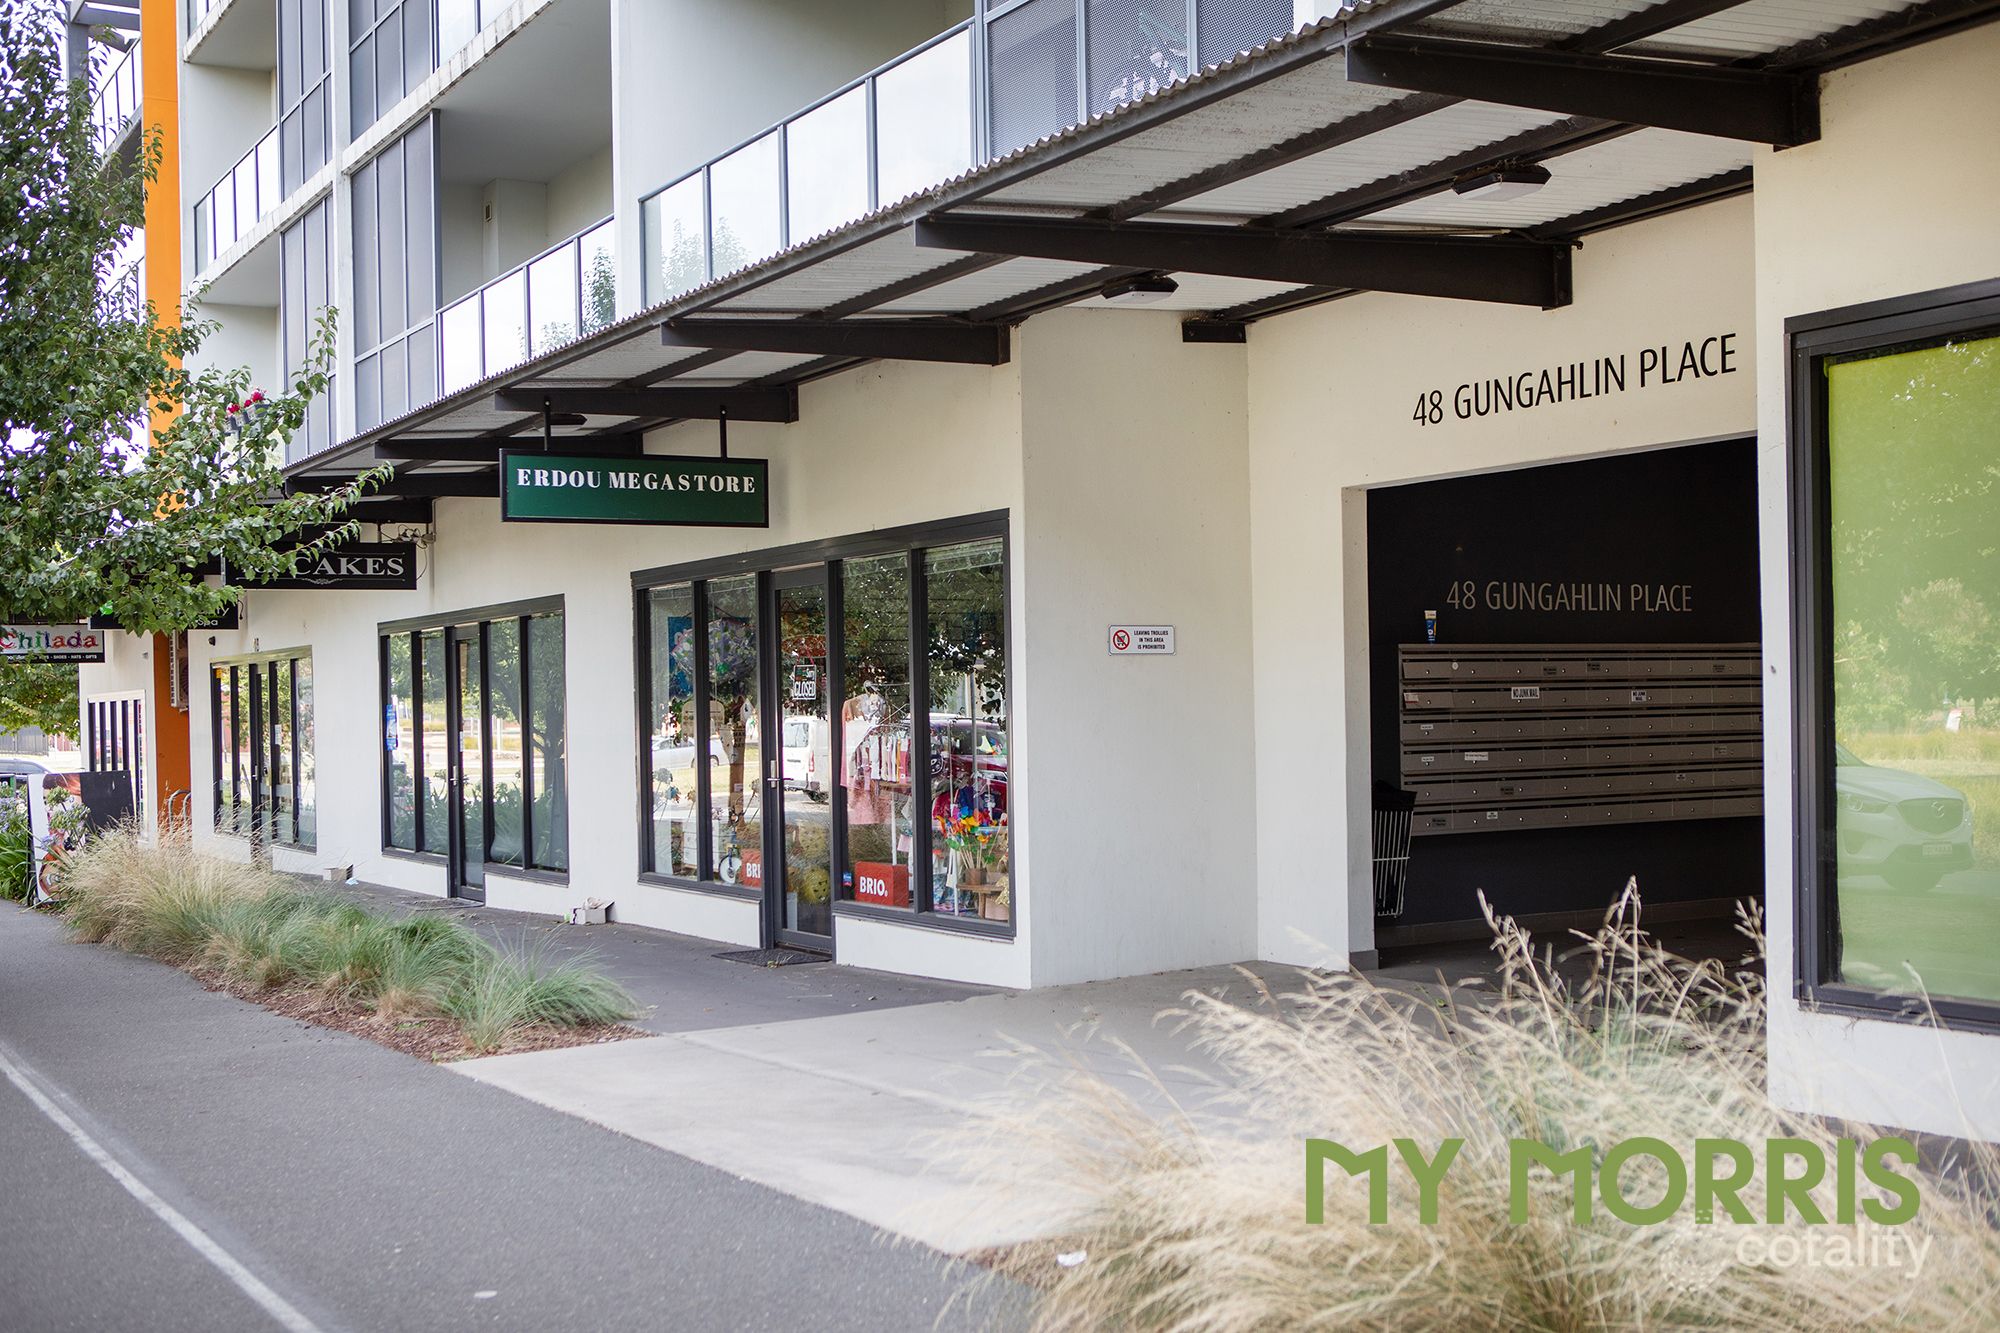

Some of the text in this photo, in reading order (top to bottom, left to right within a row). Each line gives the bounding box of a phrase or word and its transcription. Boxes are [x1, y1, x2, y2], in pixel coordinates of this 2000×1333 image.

[1412, 332, 1737, 427] 48 GUNGAHLIN PLACE
[516, 467, 756, 494] ERDOU MEGASTORE
[295, 556, 404, 576] CAKES
[1446, 580, 1693, 613] 48 GUNGAHLIN PLACE
[794, 681, 816, 698] CLOSED
